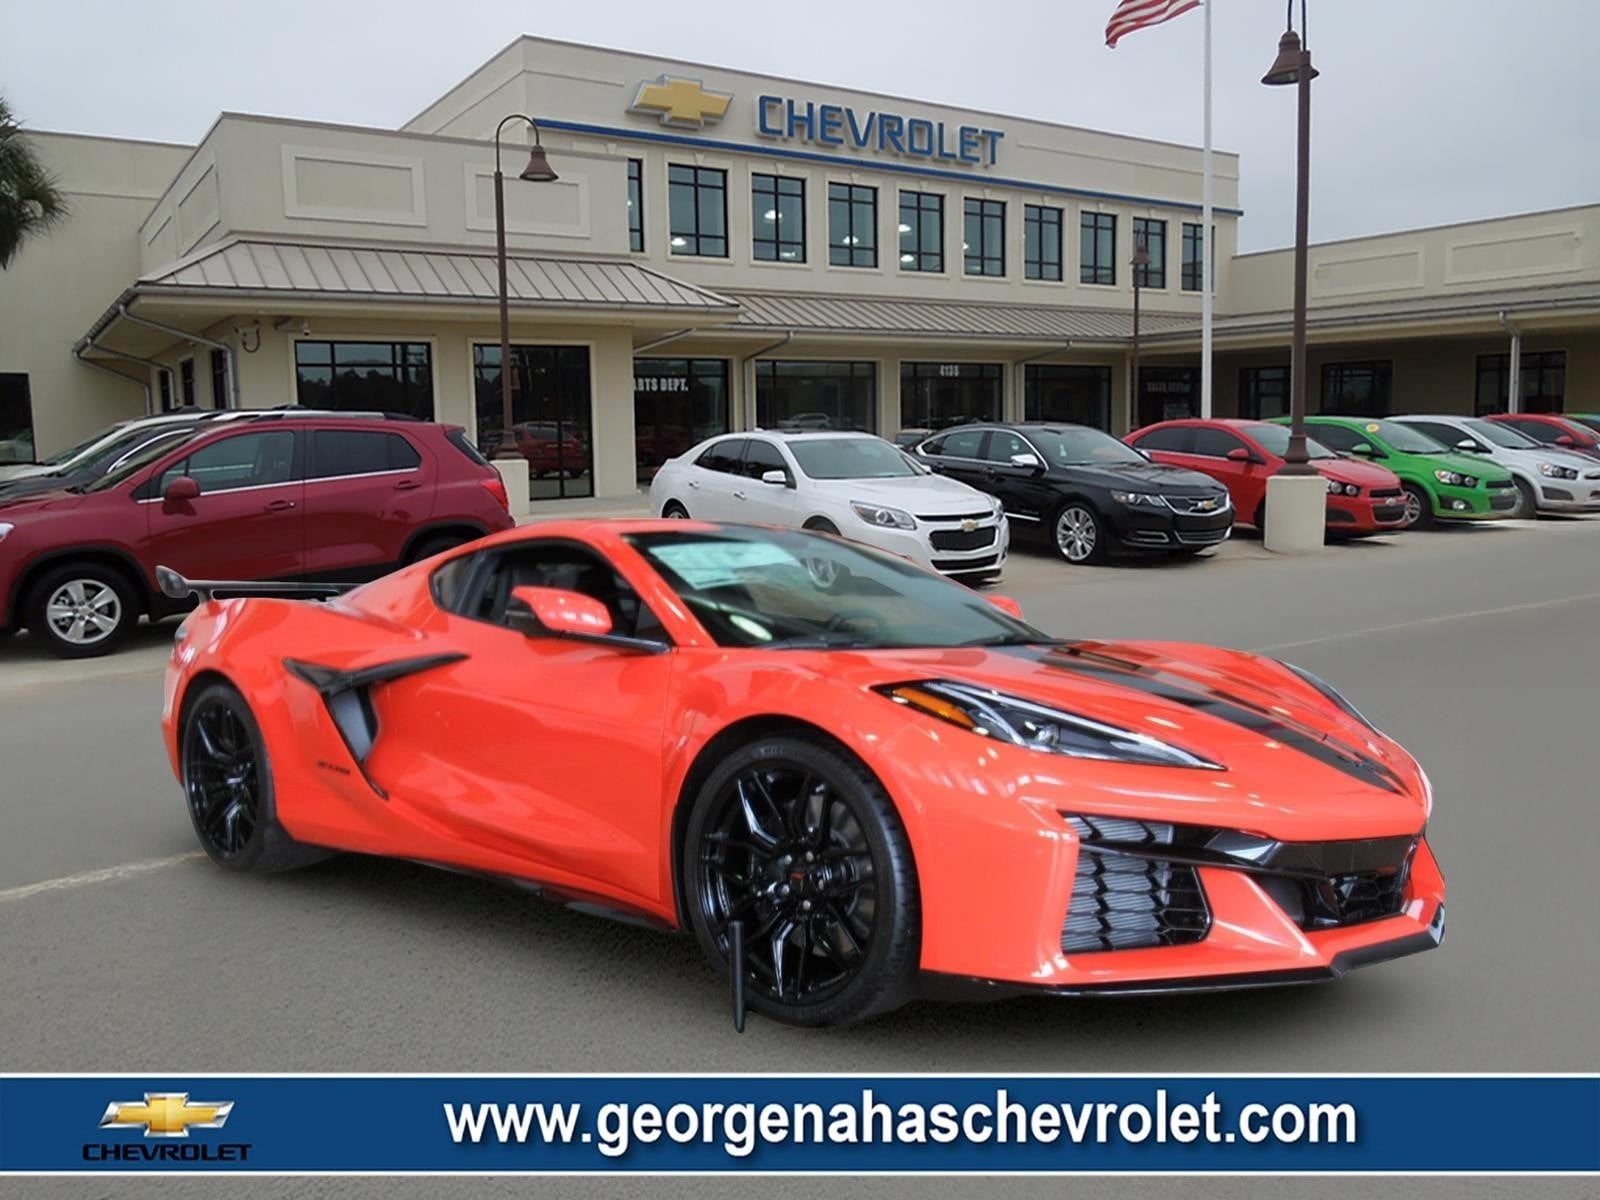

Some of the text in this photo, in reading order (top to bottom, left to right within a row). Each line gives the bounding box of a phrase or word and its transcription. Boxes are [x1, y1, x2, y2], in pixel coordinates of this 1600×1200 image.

[756, 95, 1004, 166] CHEVROLET
[634, 378, 689, 392] RTS DEPT.
